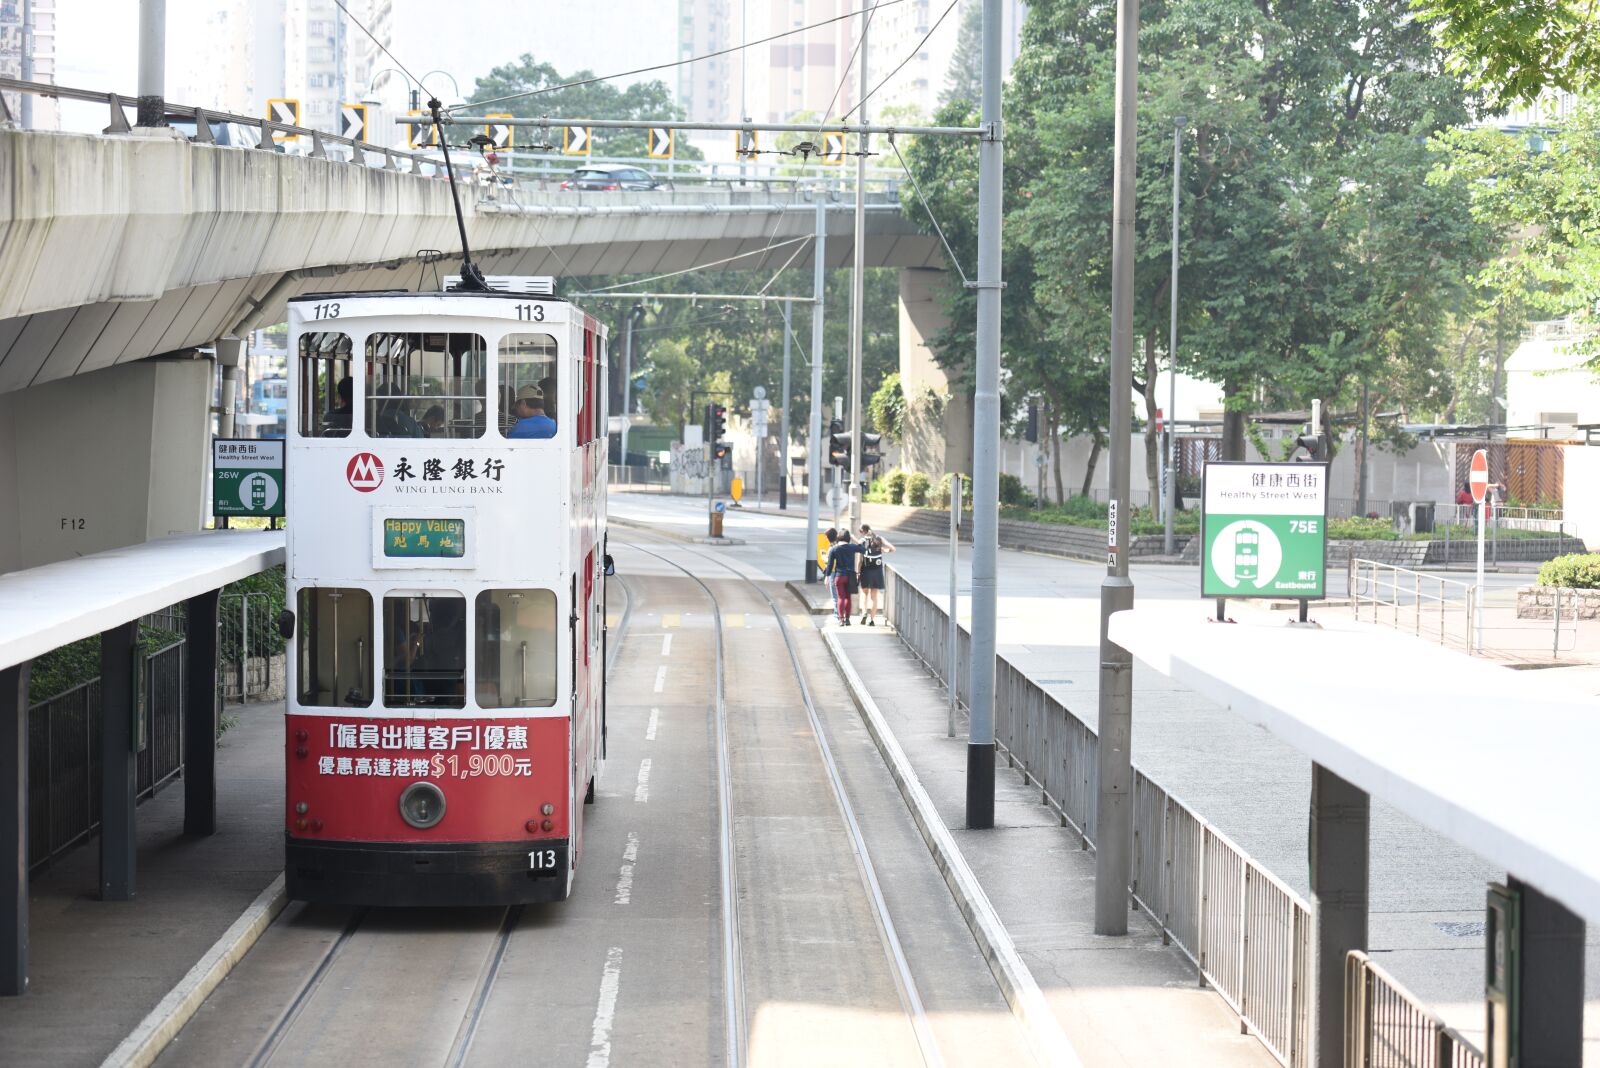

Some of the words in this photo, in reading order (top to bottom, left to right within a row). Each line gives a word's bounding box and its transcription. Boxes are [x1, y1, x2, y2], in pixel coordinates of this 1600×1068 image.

[313, 303, 340, 320] 113
[514, 304, 545, 322] 113
[218, 444, 257, 454] 健康西街
[218, 471, 240, 479] 26W
[393, 457, 506, 482] 永隆銀行
[1252, 472, 1318, 488] 健康西街
[394, 485, 427, 494] WING
[432, 485, 469, 494] LUNG
[470, 485, 503, 494] BANK
[1220, 491, 1257, 500] Healthy
[1260, 491, 1290, 500] Street
[1292, 491, 1318, 500] West
[386, 519, 422, 534] Happy
[426, 519, 461, 534] Valley
[1289, 520, 1318, 534] 75E
[1275, 581, 1317, 590] Eastbound
[528, 850, 556, 869] 113
